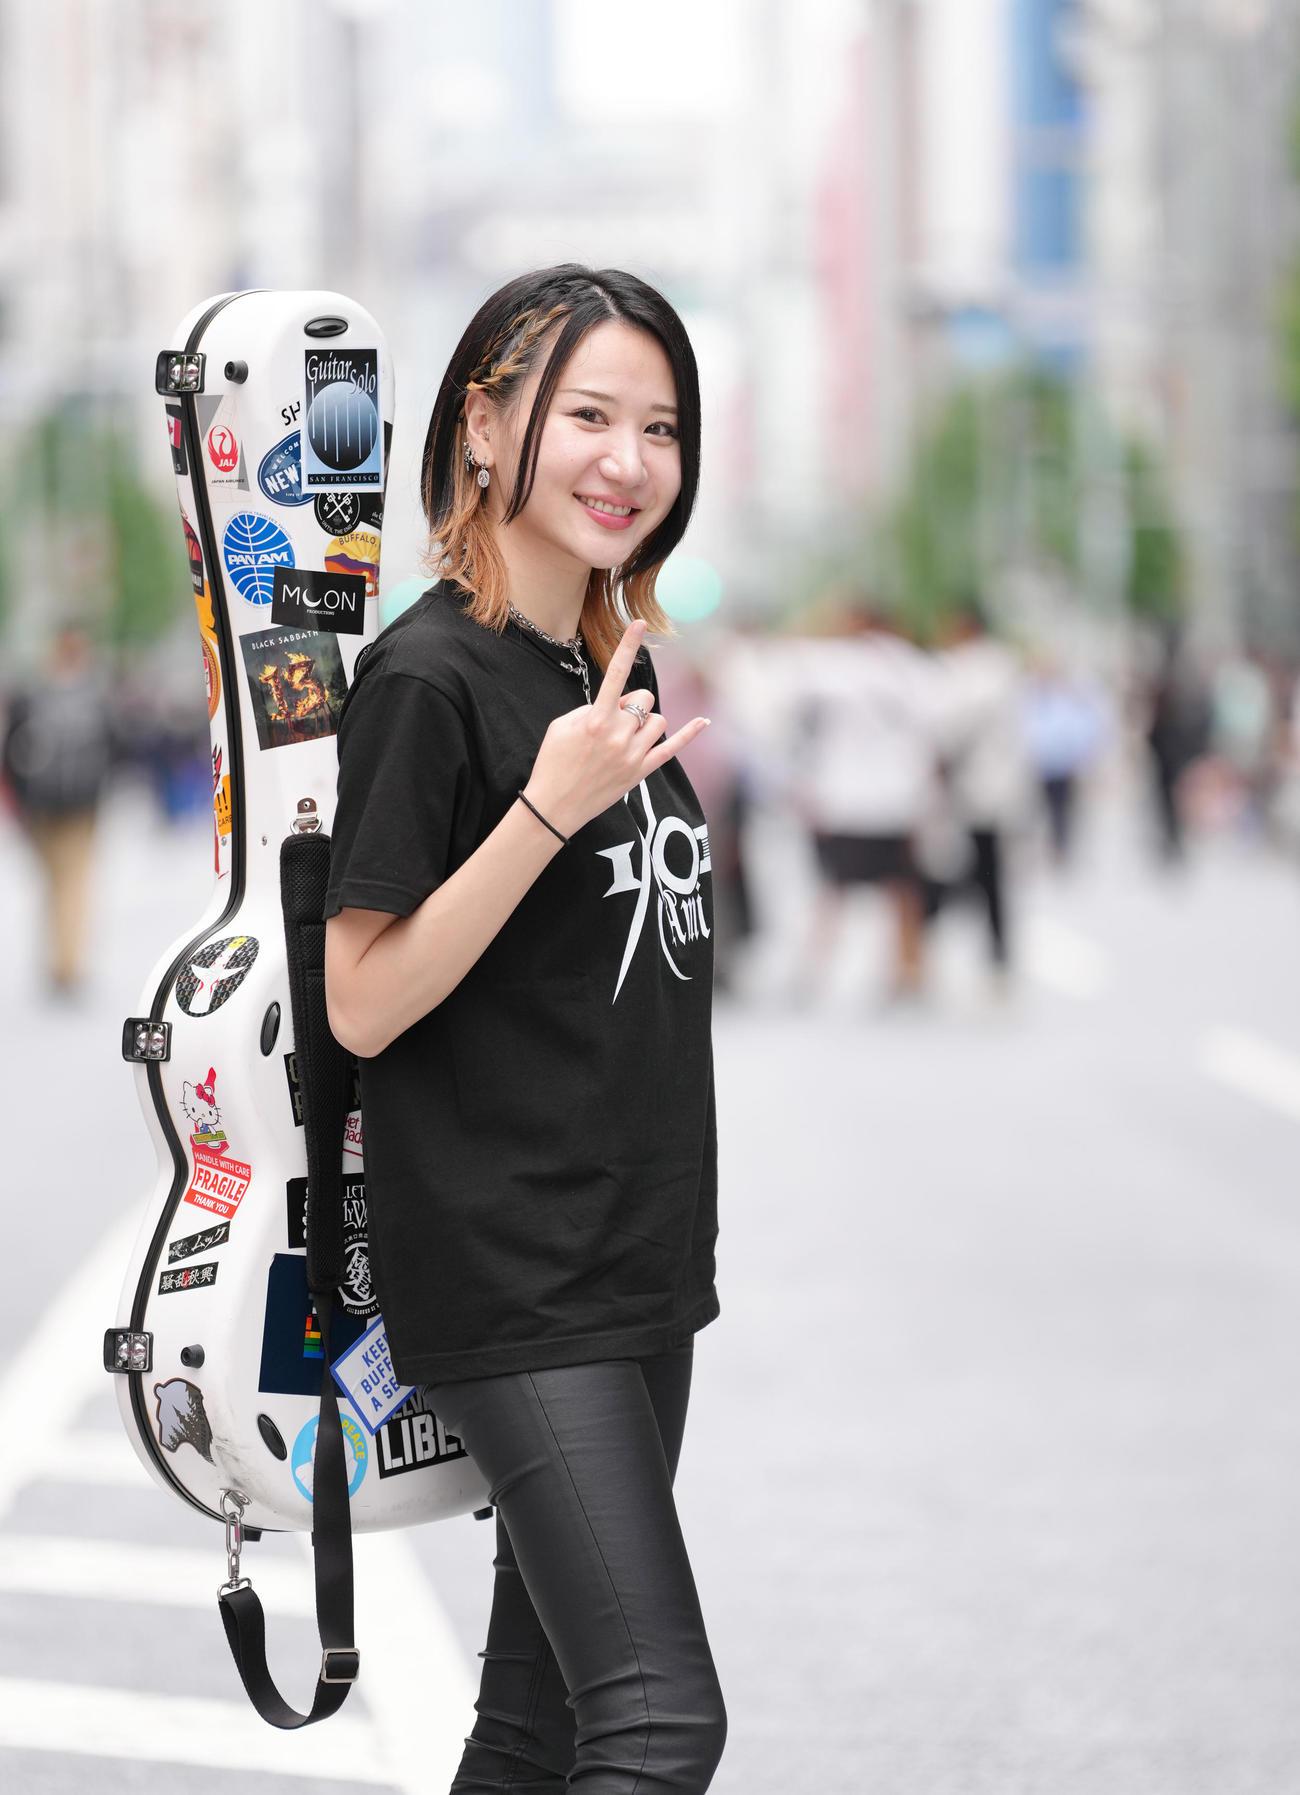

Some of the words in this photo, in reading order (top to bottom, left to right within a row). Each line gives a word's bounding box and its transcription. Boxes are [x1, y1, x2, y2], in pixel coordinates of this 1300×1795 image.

[306, 352, 352, 383] Guitar
[349, 362, 376, 394] Solo
[218, 459, 235, 467] JAL
[264, 463, 300, 495] NEW
[227, 553, 255, 565] PAN
[257, 551, 290, 565] AM
[281, 584, 356, 612] MOON
[306, 608, 335, 616] PRODUCTIONS
[251, 638, 275, 650] BLACK
[278, 630, 319, 644] SABBATH
[194, 1152, 219, 1167] HANDLE
[219, 1160, 234, 1172] WITH
[235, 1164, 250, 1177] CARE
[195, 1167, 245, 1202] FRAGILE
[193, 1194, 215, 1209] THANK
[215, 1200, 230, 1214] YOU
[371, 1396, 383, 1412] A
[341, 1419, 365, 1460] PEACE
